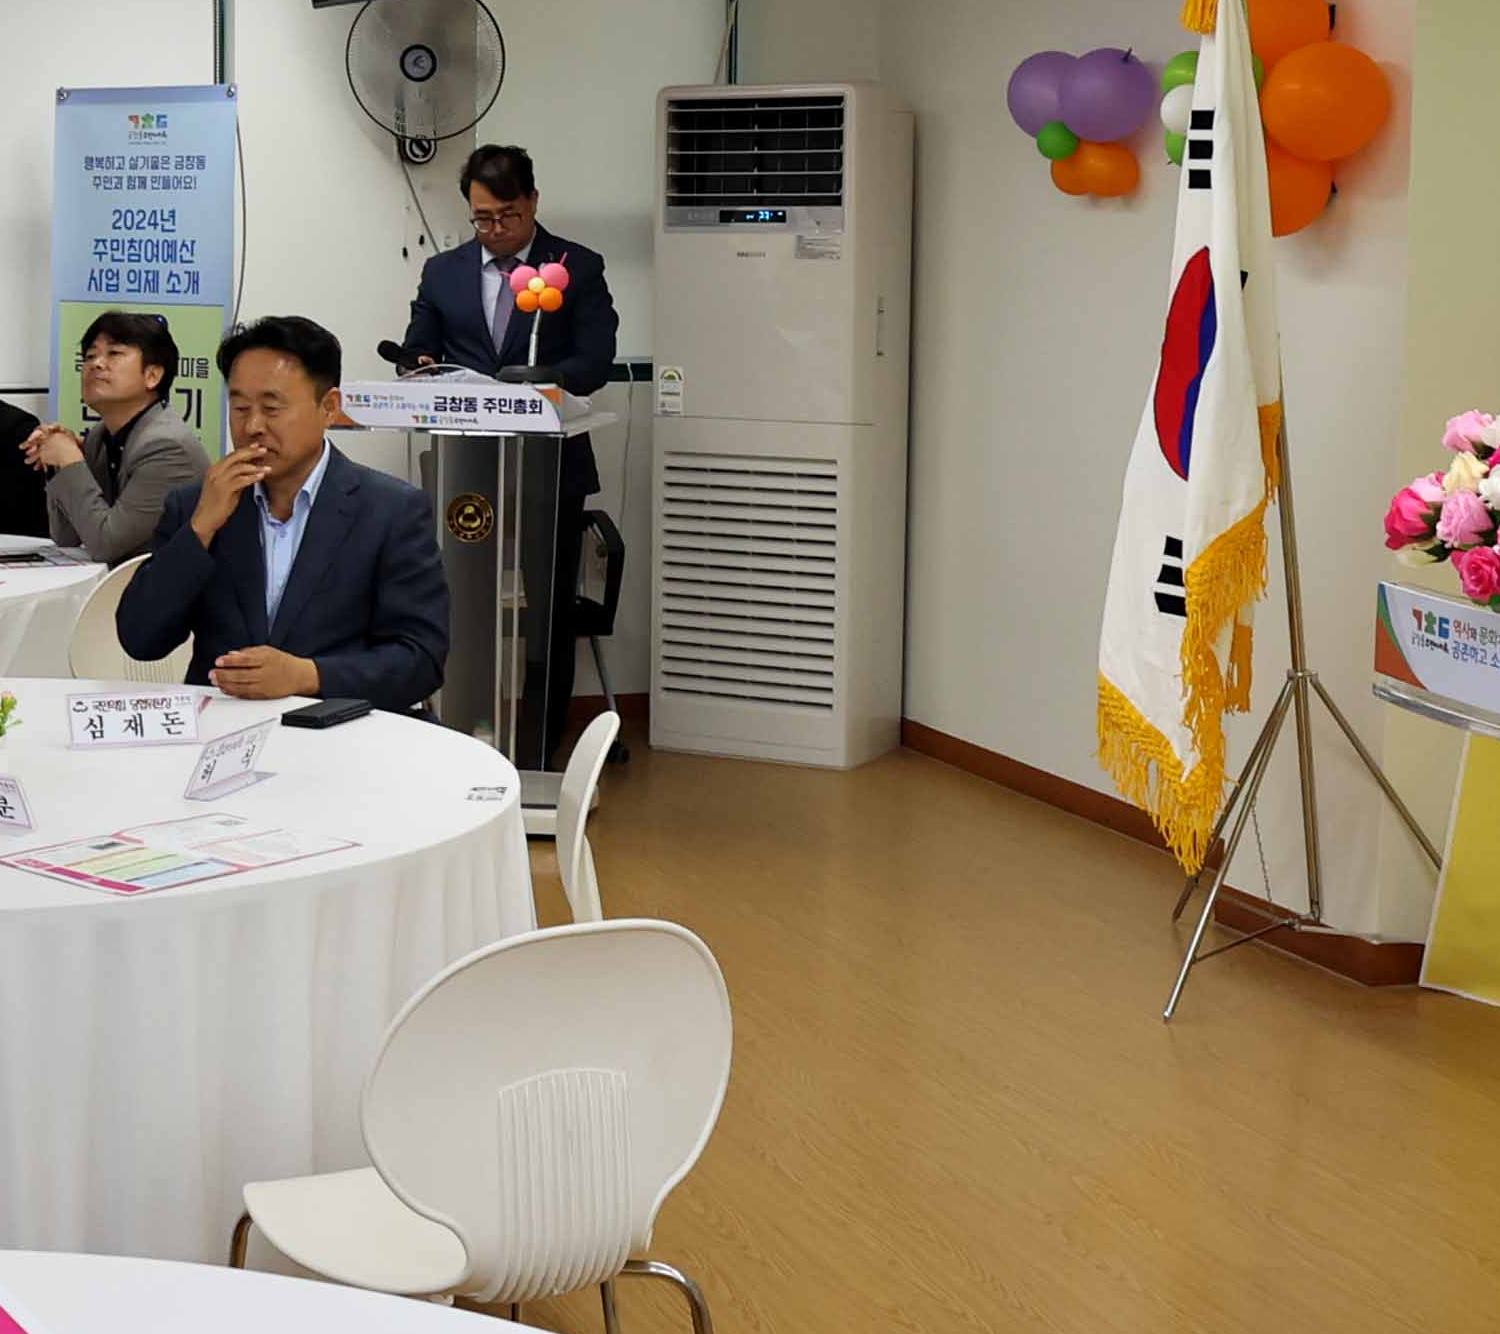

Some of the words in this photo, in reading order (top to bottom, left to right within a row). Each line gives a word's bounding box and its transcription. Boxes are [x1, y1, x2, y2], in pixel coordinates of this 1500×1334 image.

[174, 155, 207, 171] 금창동
[112, 209, 177, 233] 2024년
[92, 238, 196, 264] 주민참여예산
[88, 268, 120, 293] 사업
[126, 269, 160, 295] 의제
[166, 270, 200, 295] 소개
[433, 395, 478, 413] 금창동
[483, 397, 543, 416] 주민총회
